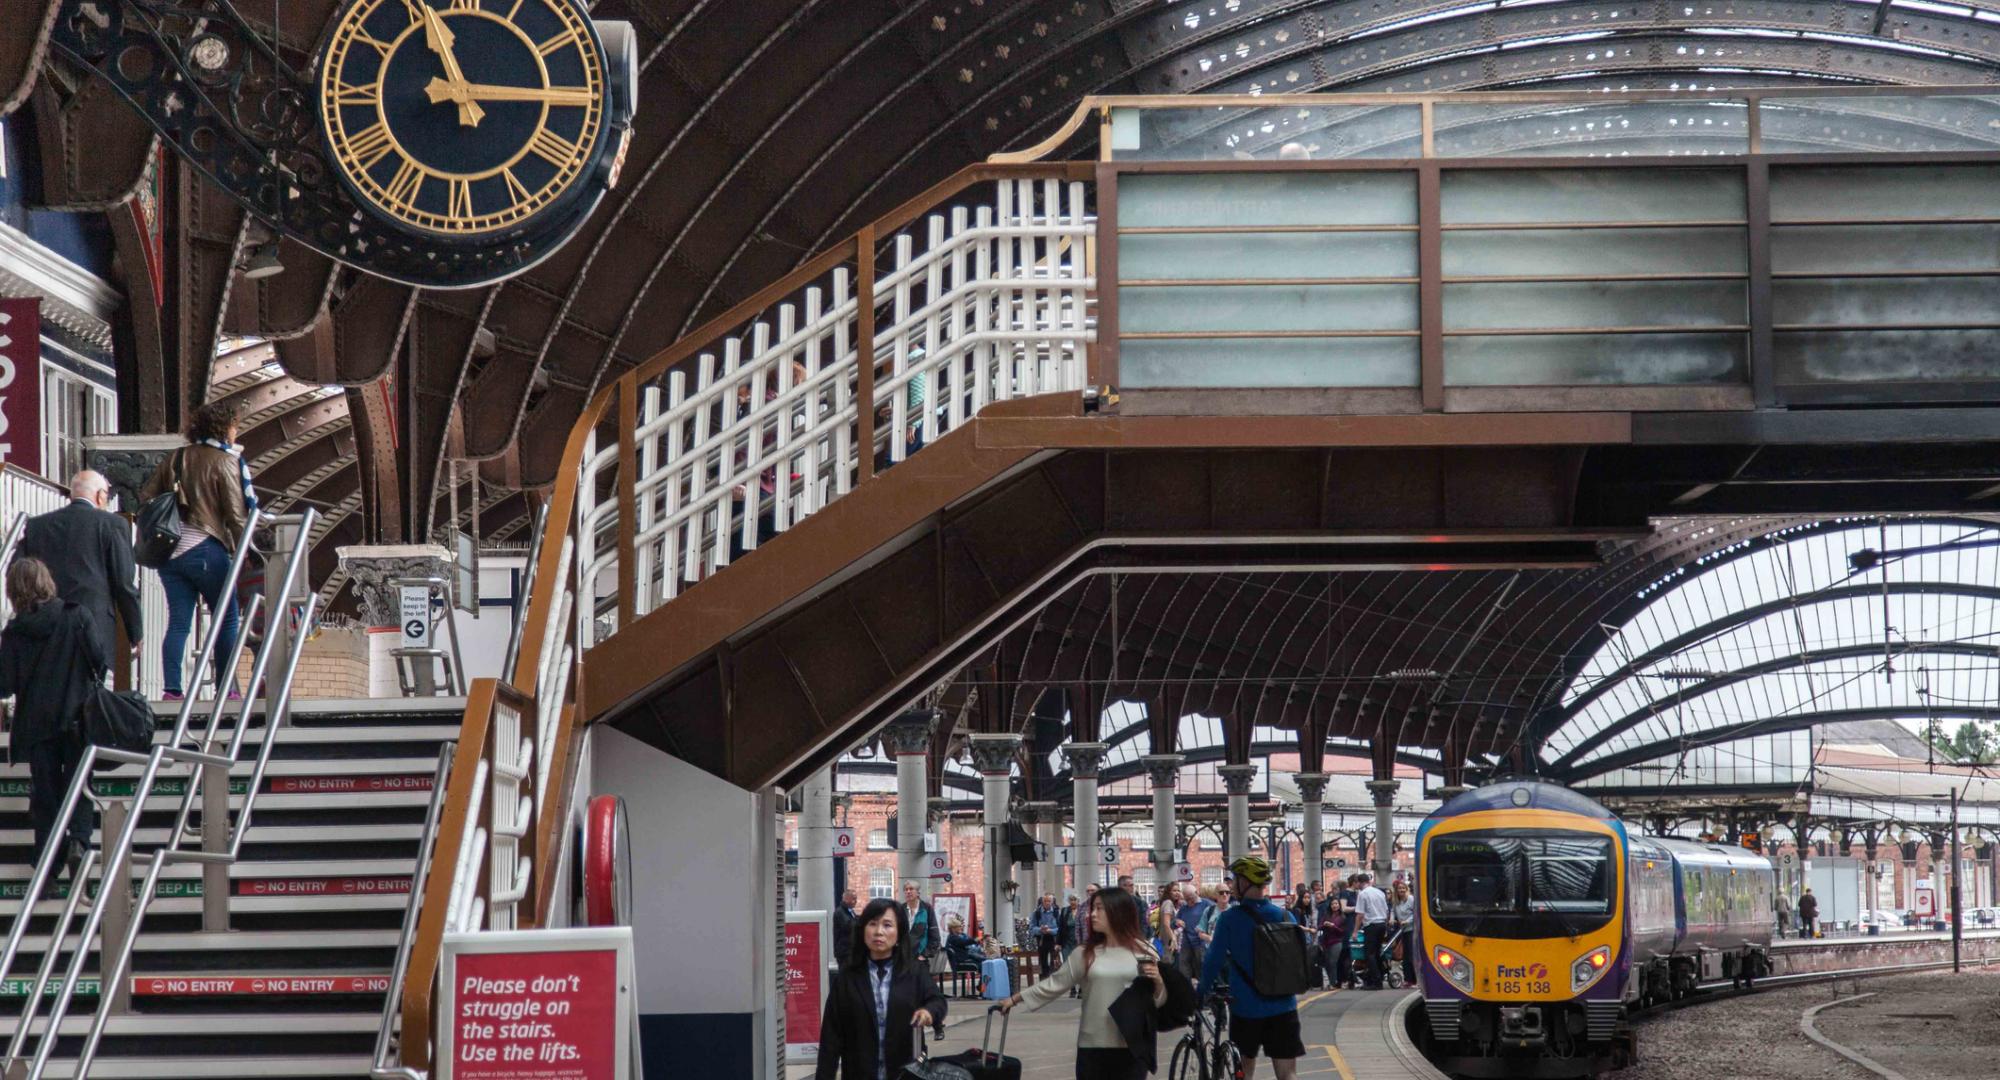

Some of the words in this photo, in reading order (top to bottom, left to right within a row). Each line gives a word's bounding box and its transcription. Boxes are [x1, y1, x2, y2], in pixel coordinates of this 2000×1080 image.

[300, 780, 317, 790] NO
[319, 779, 357, 789] ENTRY
[384, 779, 401, 788] NO
[402, 778, 434, 788] ENTR
[1061, 849, 1067, 862] 1
[1104, 847, 1115, 862] 3
[1784, 854, 1791, 864] 3
[268, 882, 285, 892] NO
[289, 881, 327, 892] ENTRY
[357, 881, 374, 890] NO
[1498, 965, 1526, 978] First
[168, 981, 187, 992] NO
[191, 980, 234, 992] ENTRY
[268, 981, 288, 991] NO
[291, 980, 334, 991] ENTRY
[369, 980, 388, 990] NO
[463, 976, 527, 995] Please
[531, 974, 580, 993] don't
[1496, 981, 1520, 993] 185
[1527, 981, 1550, 993] 138
[462, 999, 541, 1020] struggle
[546, 1001, 570, 1015] on
[463, 1022, 494, 1039] the
[498, 1021, 556, 1038] stairs.
[461, 1044, 497, 1061] Use
[503, 1043, 535, 1061] the
[540, 1042, 581, 1063] lifts.
